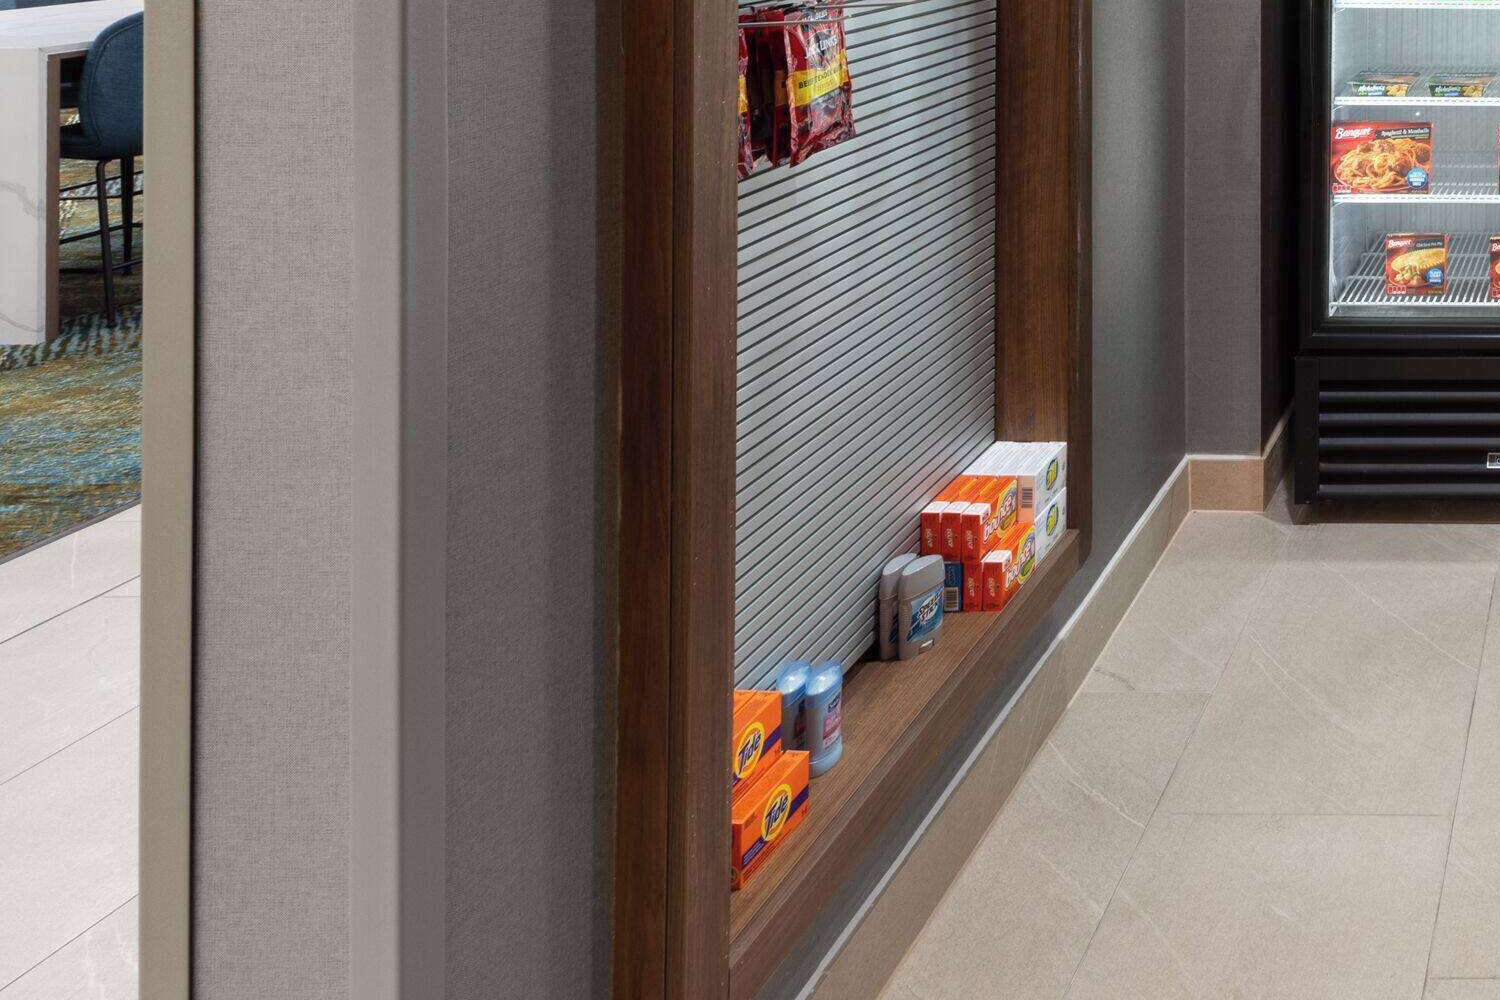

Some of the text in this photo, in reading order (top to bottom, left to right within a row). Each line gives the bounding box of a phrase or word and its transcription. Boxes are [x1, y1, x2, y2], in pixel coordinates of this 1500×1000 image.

[1335, 127, 1374, 140] Banquet
[738, 731, 762, 772] Tide
[765, 792, 789, 837] Tide
